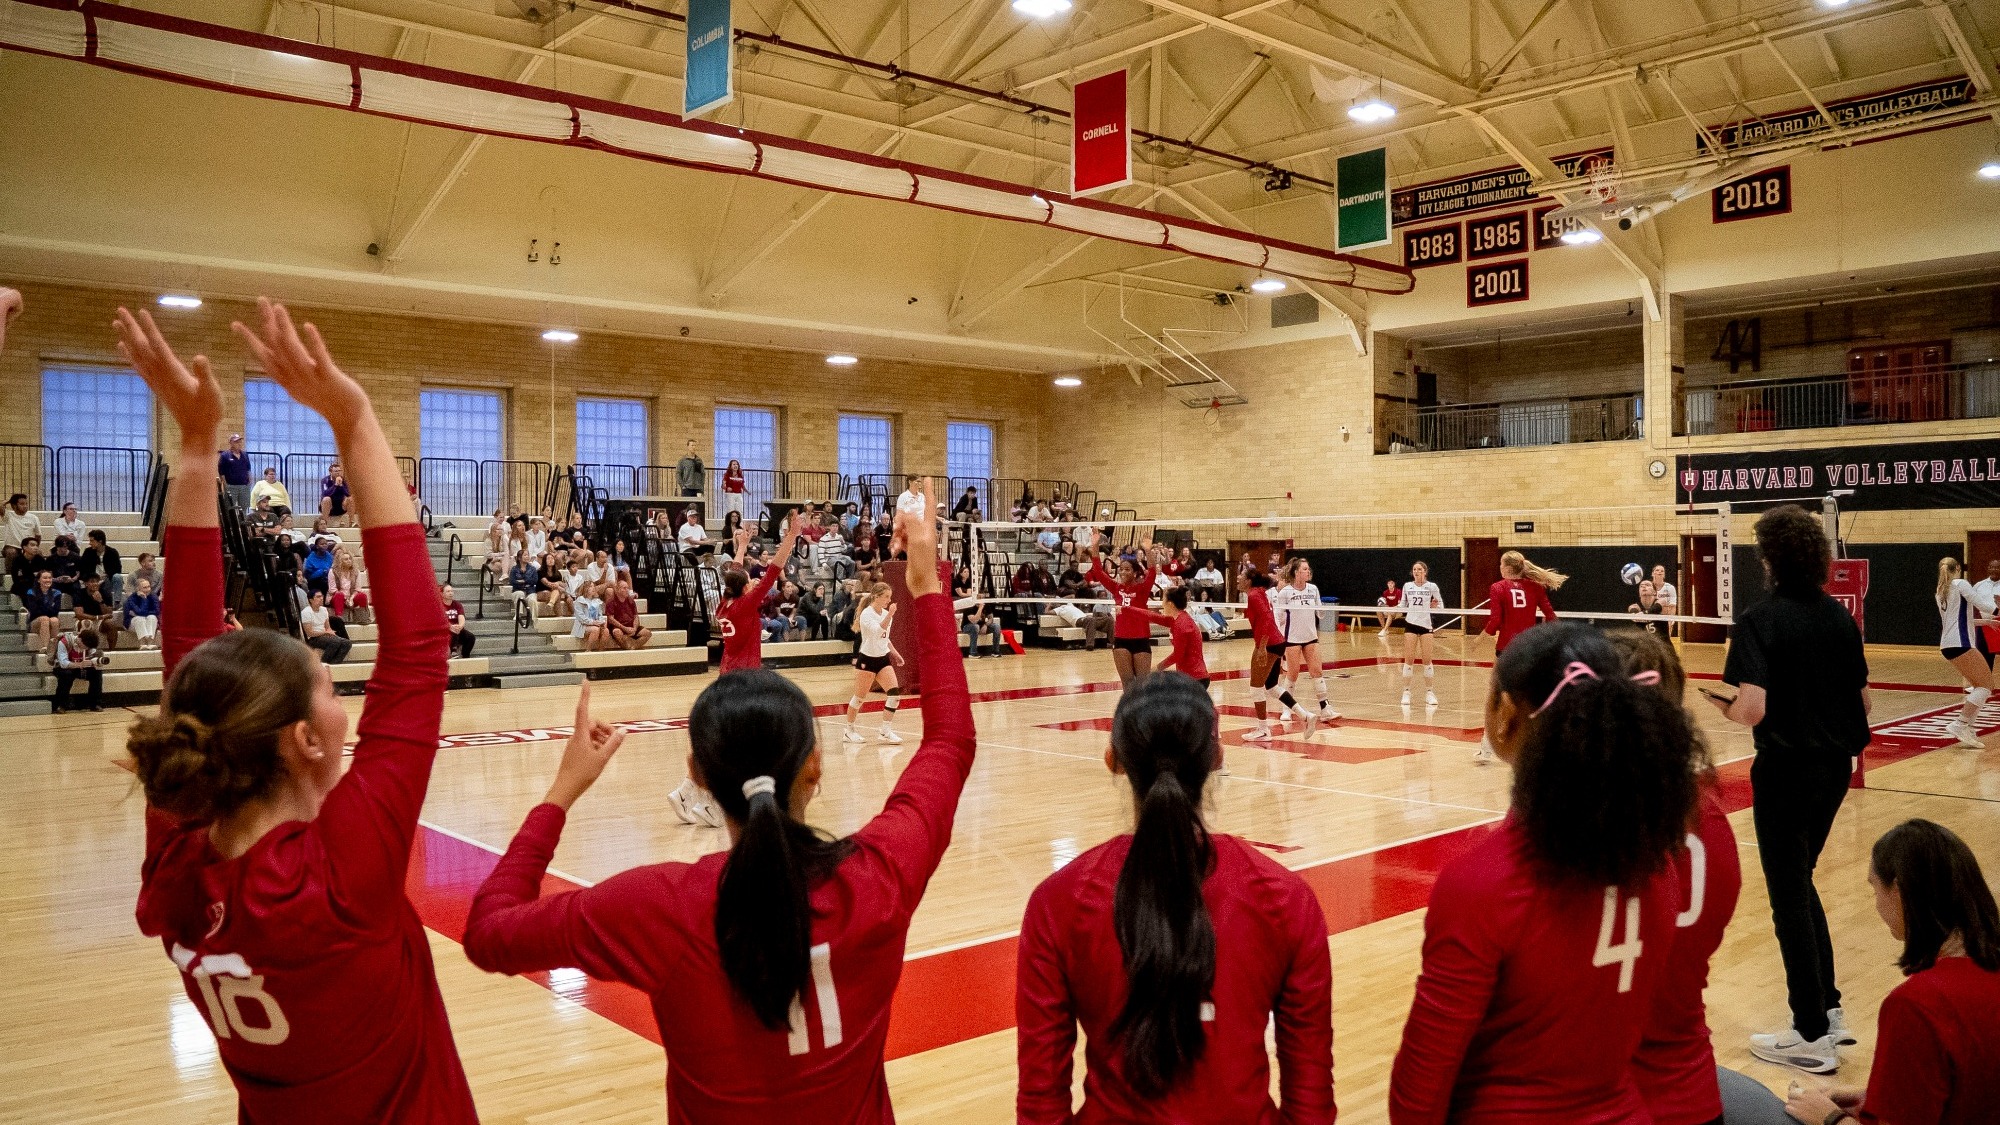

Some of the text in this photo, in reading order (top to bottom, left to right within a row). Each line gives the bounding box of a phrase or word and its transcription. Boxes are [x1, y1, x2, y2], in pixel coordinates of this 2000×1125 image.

[691, 25, 724, 51] COLUMBIA
[1807, 108, 1854, 127] MN'S
[1858, 86, 1961, 117] VOLLEYBALL
[1082, 123, 1118, 141] CORNELL
[1339, 190, 1384, 208] DARTMOUTH
[1418, 183, 1469, 202] HARVARD
[1471, 175, 1506, 192] MEN'S
[1418, 205, 1432, 215] IVY
[1434, 197, 1465, 212] LEAGUE
[1467, 186, 1525, 206] TOURNAMENT
[1722, 178, 1780, 212] 2018
[1410, 232, 1454, 261] 1983
[1473, 221, 1521, 251] 1985
[1474, 269, 1521, 298] 2001
[1710, 316, 1760, 374] 44
[1703, 458, 2000, 490] HARVARD VOLLEYBALL
[1722, 529, 1730, 612] CRIMSON
[1412, 596, 1423, 606] 22
[1510, 588, 1527, 608] 13
